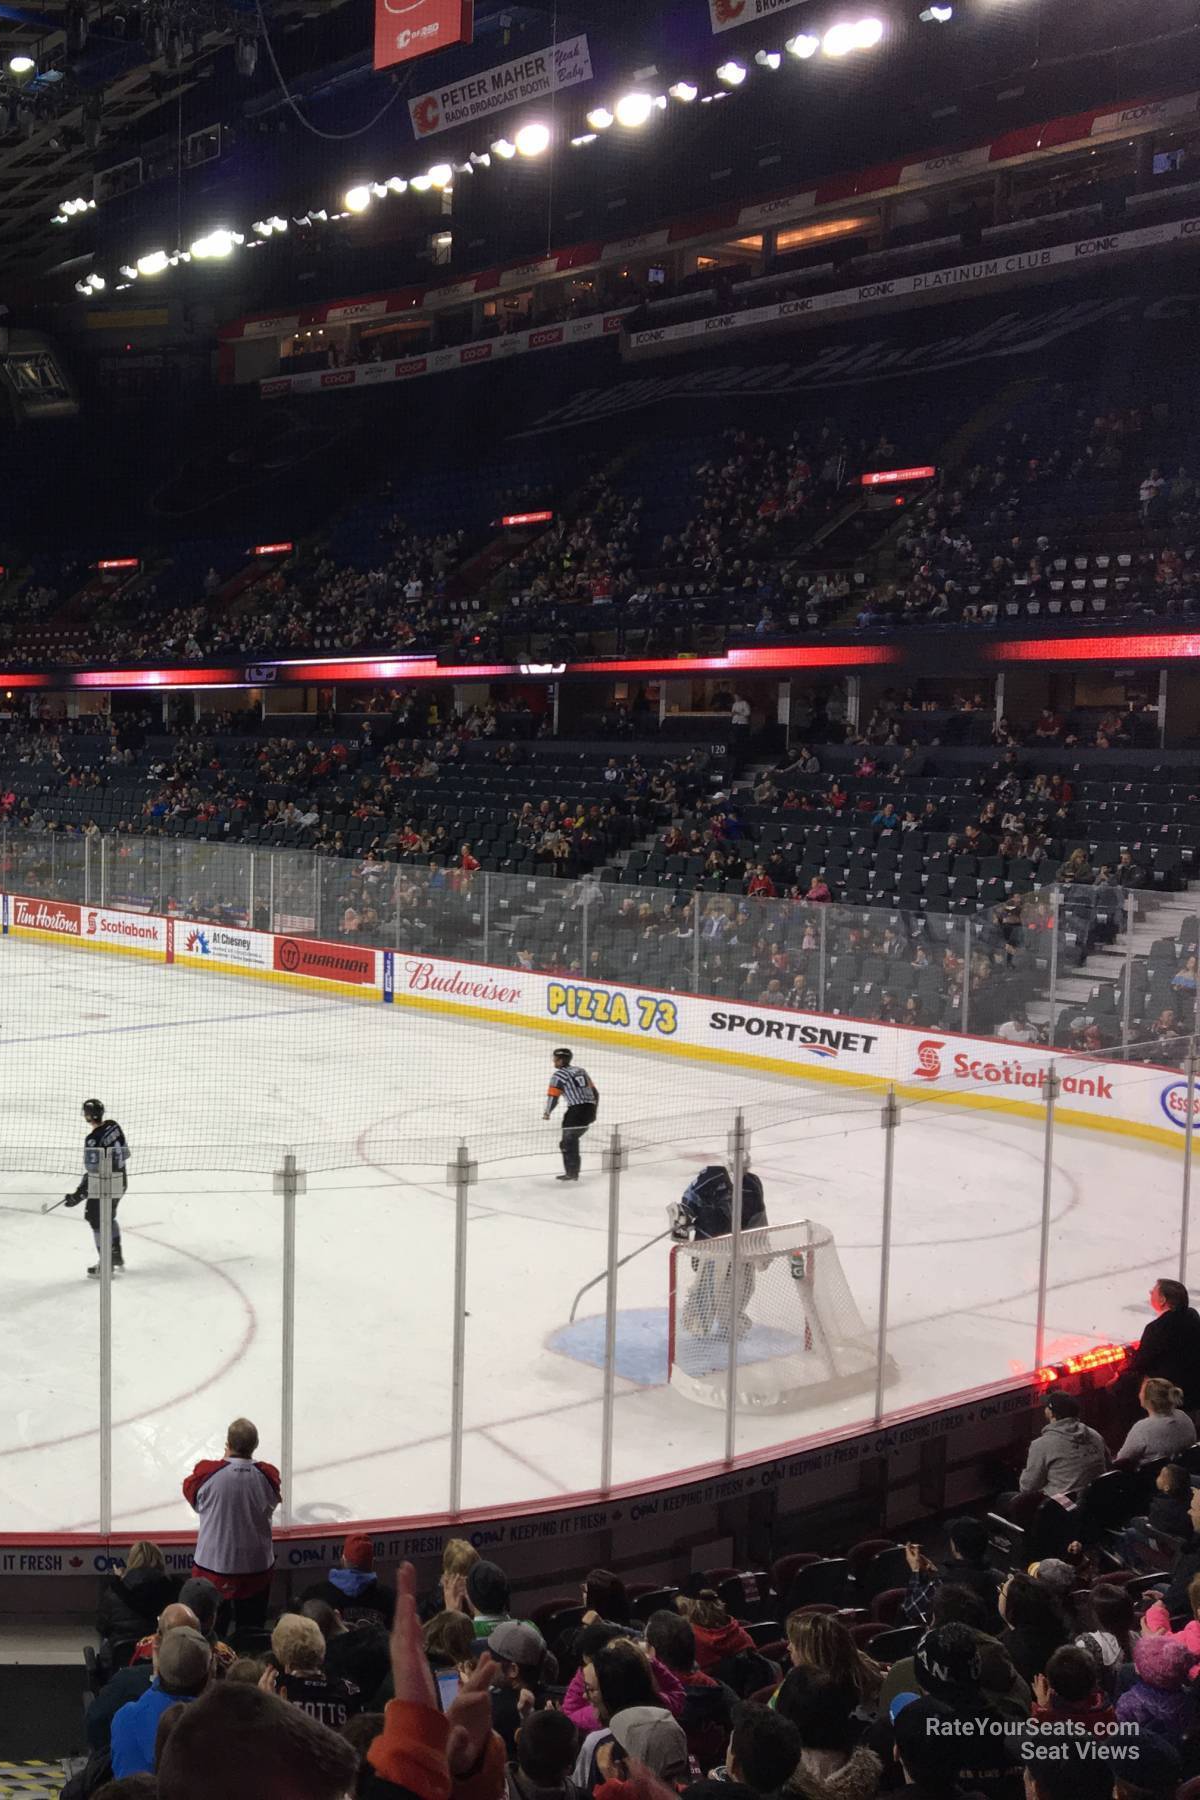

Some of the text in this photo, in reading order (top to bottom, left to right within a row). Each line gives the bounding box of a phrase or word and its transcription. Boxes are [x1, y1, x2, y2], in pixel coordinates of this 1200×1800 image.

[441, 57, 548, 109] PETER MAHER
[445, 76, 551, 124] RADIO BROADCAST BOOTH
[1074, 236, 1120, 257] ICONIC
[912, 251, 1051, 292] PLATINUM CLUB
[858, 282, 896, 300] ICONIC
[778, 299, 814, 316] ICONIC
[705, 315, 737, 330] ICONIC
[636, 330, 666, 345] ICONIC
[711, 744, 726, 755] 120
[16, 901, 35, 925] Tim
[36, 904, 79, 933] Hortons
[101, 918, 159, 941] Scotiabank
[221, 933, 251, 951] Chesney
[303, 952, 369, 974] WARRIOR
[405, 960, 522, 1004] Budweiser
[547, 982, 678, 1035] PIZZA 73
[710, 1012, 879, 1055] SPORTSNET
[631, 1499, 659, 1521] OPA!
[663, 1490, 703, 1514] KEEPING
[716, 1479, 744, 1499] FRESH
[471, 1512, 607, 1548] OPA! KEEPING IT FRESH
[4, 1555, 16, 1570] IT
[20, 1555, 63, 1571] FRESH
[289, 1544, 326, 1565] OPA!
[389, 1541, 400, 1556] IT
[405, 1536, 443, 1553] FRESH
